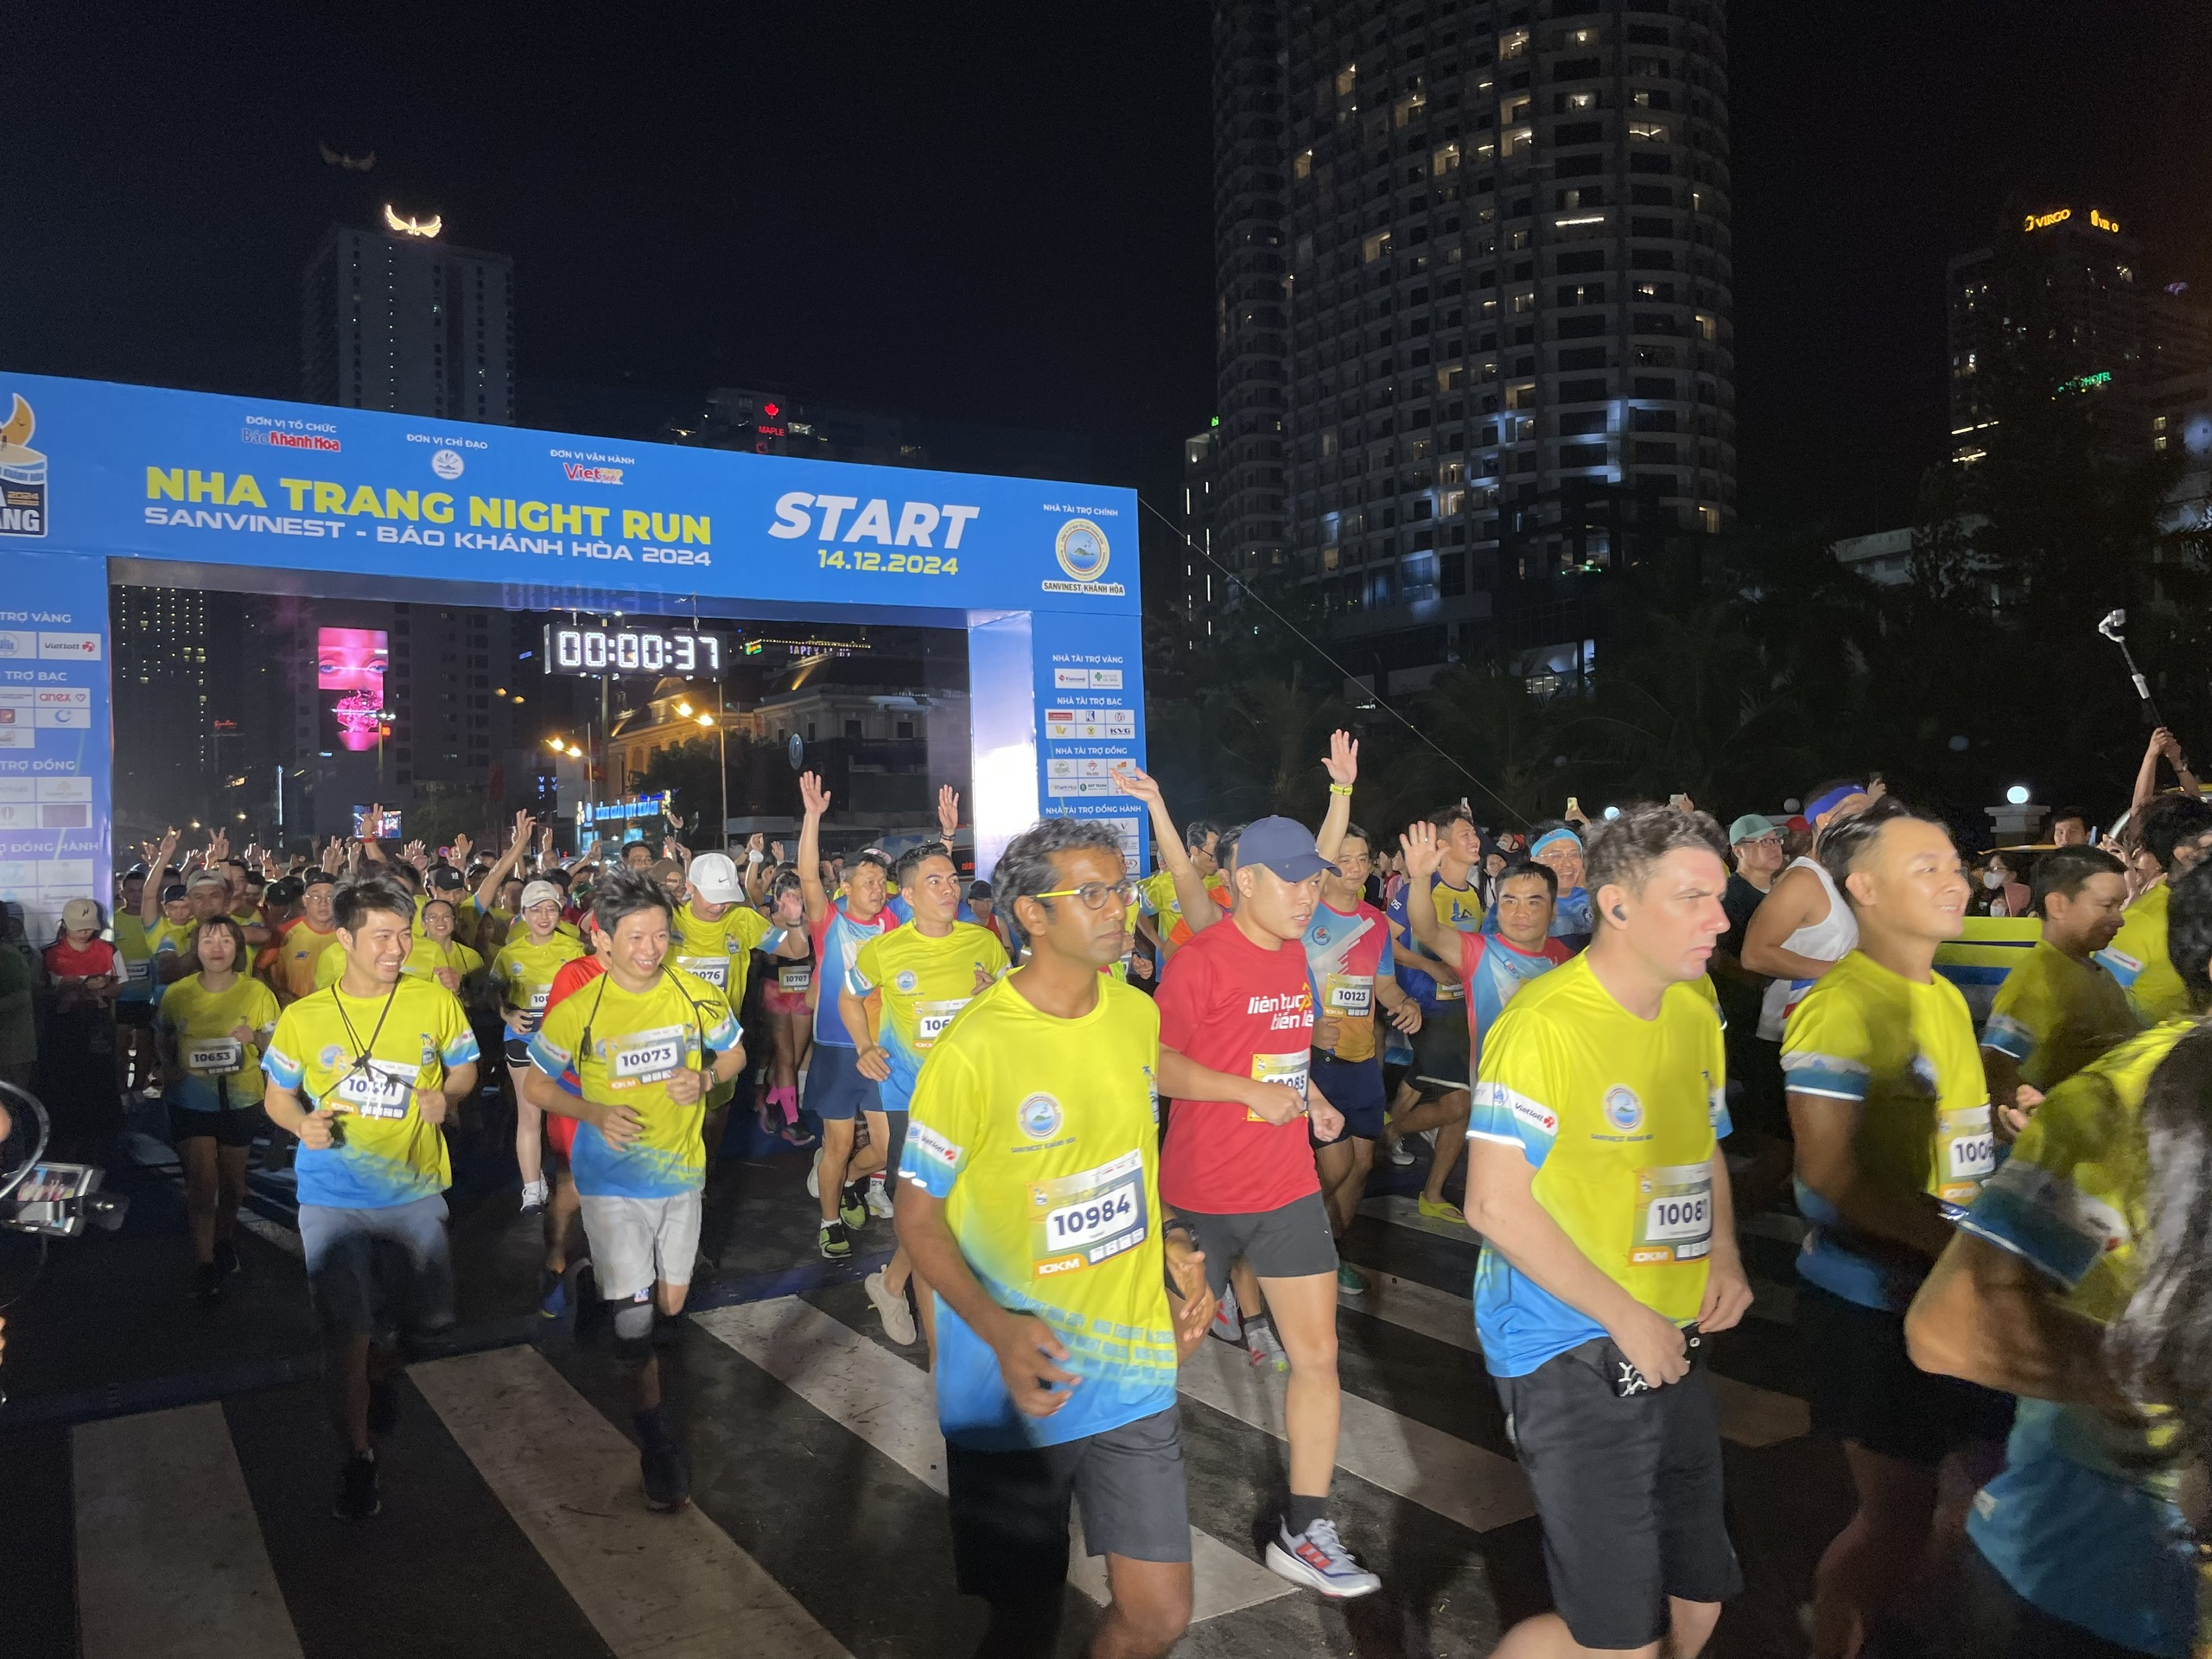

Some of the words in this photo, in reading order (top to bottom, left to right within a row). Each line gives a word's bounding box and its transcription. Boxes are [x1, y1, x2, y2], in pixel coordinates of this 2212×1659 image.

[2036, 209, 2071, 227] VIRGO
[246, 416, 272, 426] ĐƠN
[759, 425, 785, 436] MAPLE
[406, 434, 430, 443] ĐƠN
[550, 449, 572, 459] ĐƠN
[607, 454, 635, 465] HÀNH
[147, 467, 266, 508] NHA
[281, 478, 454, 524] TRANG
[470, 496, 609, 537] NIGHT
[623, 510, 711, 545] RUN
[1062, 505, 1075, 513] TÀI
[1077, 506, 1092, 516] TRỢ
[1094, 507, 1118, 517] CHÍNH
[768, 492, 980, 550] START
[145, 506, 346, 538] SANVINEST
[377, 524, 445, 546] BÁO
[454, 532, 563, 556] KHÁNH
[572, 539, 633, 562] HÒA
[642, 547, 712, 567] 2024
[817, 549, 959, 575] 14.12.2024
[1044, 582, 1081, 591] SANVINEST
[1084, 582, 1108, 593] KHÁNH
[1109, 583, 1124, 594] HÒA
[32, 611, 71, 623] VÀNG
[559, 632, 719, 671] 00:00:37
[1052, 654, 1070, 663] NHÀ
[1071, 654, 1084, 663] TÀI
[1084, 655, 1101, 664] TRỢ
[1101, 654, 1123, 664] VÀNG
[4, 670, 34, 683] TRỢ
[38, 671, 67, 683] BẠC
[1057, 696, 1074, 705] NHÀ
[1076, 696, 1088, 705] TÀI
[1089, 696, 1105, 706] TRỢ
[1106, 697, 1122, 707] BẠC
[1105, 746, 1128, 754] ĐỒNG
[33, 758, 75, 771] ĐỒNG
[1064, 805, 1077, 814] TÀI
[1078, 805, 1095, 815] TRỢ
[1095, 804, 1117, 813] ĐỒNG
[1119, 804, 1141, 812] HÀNH
[1338, 990, 1366, 1001] 10123
[1248, 995, 1279, 1014] liên
[1270, 1011, 1300, 1030] tiến
[194, 1052, 231, 1063] 10653
[622, 1047, 671, 1067] 10073
[1053, 1193, 1130, 1236] 10984
